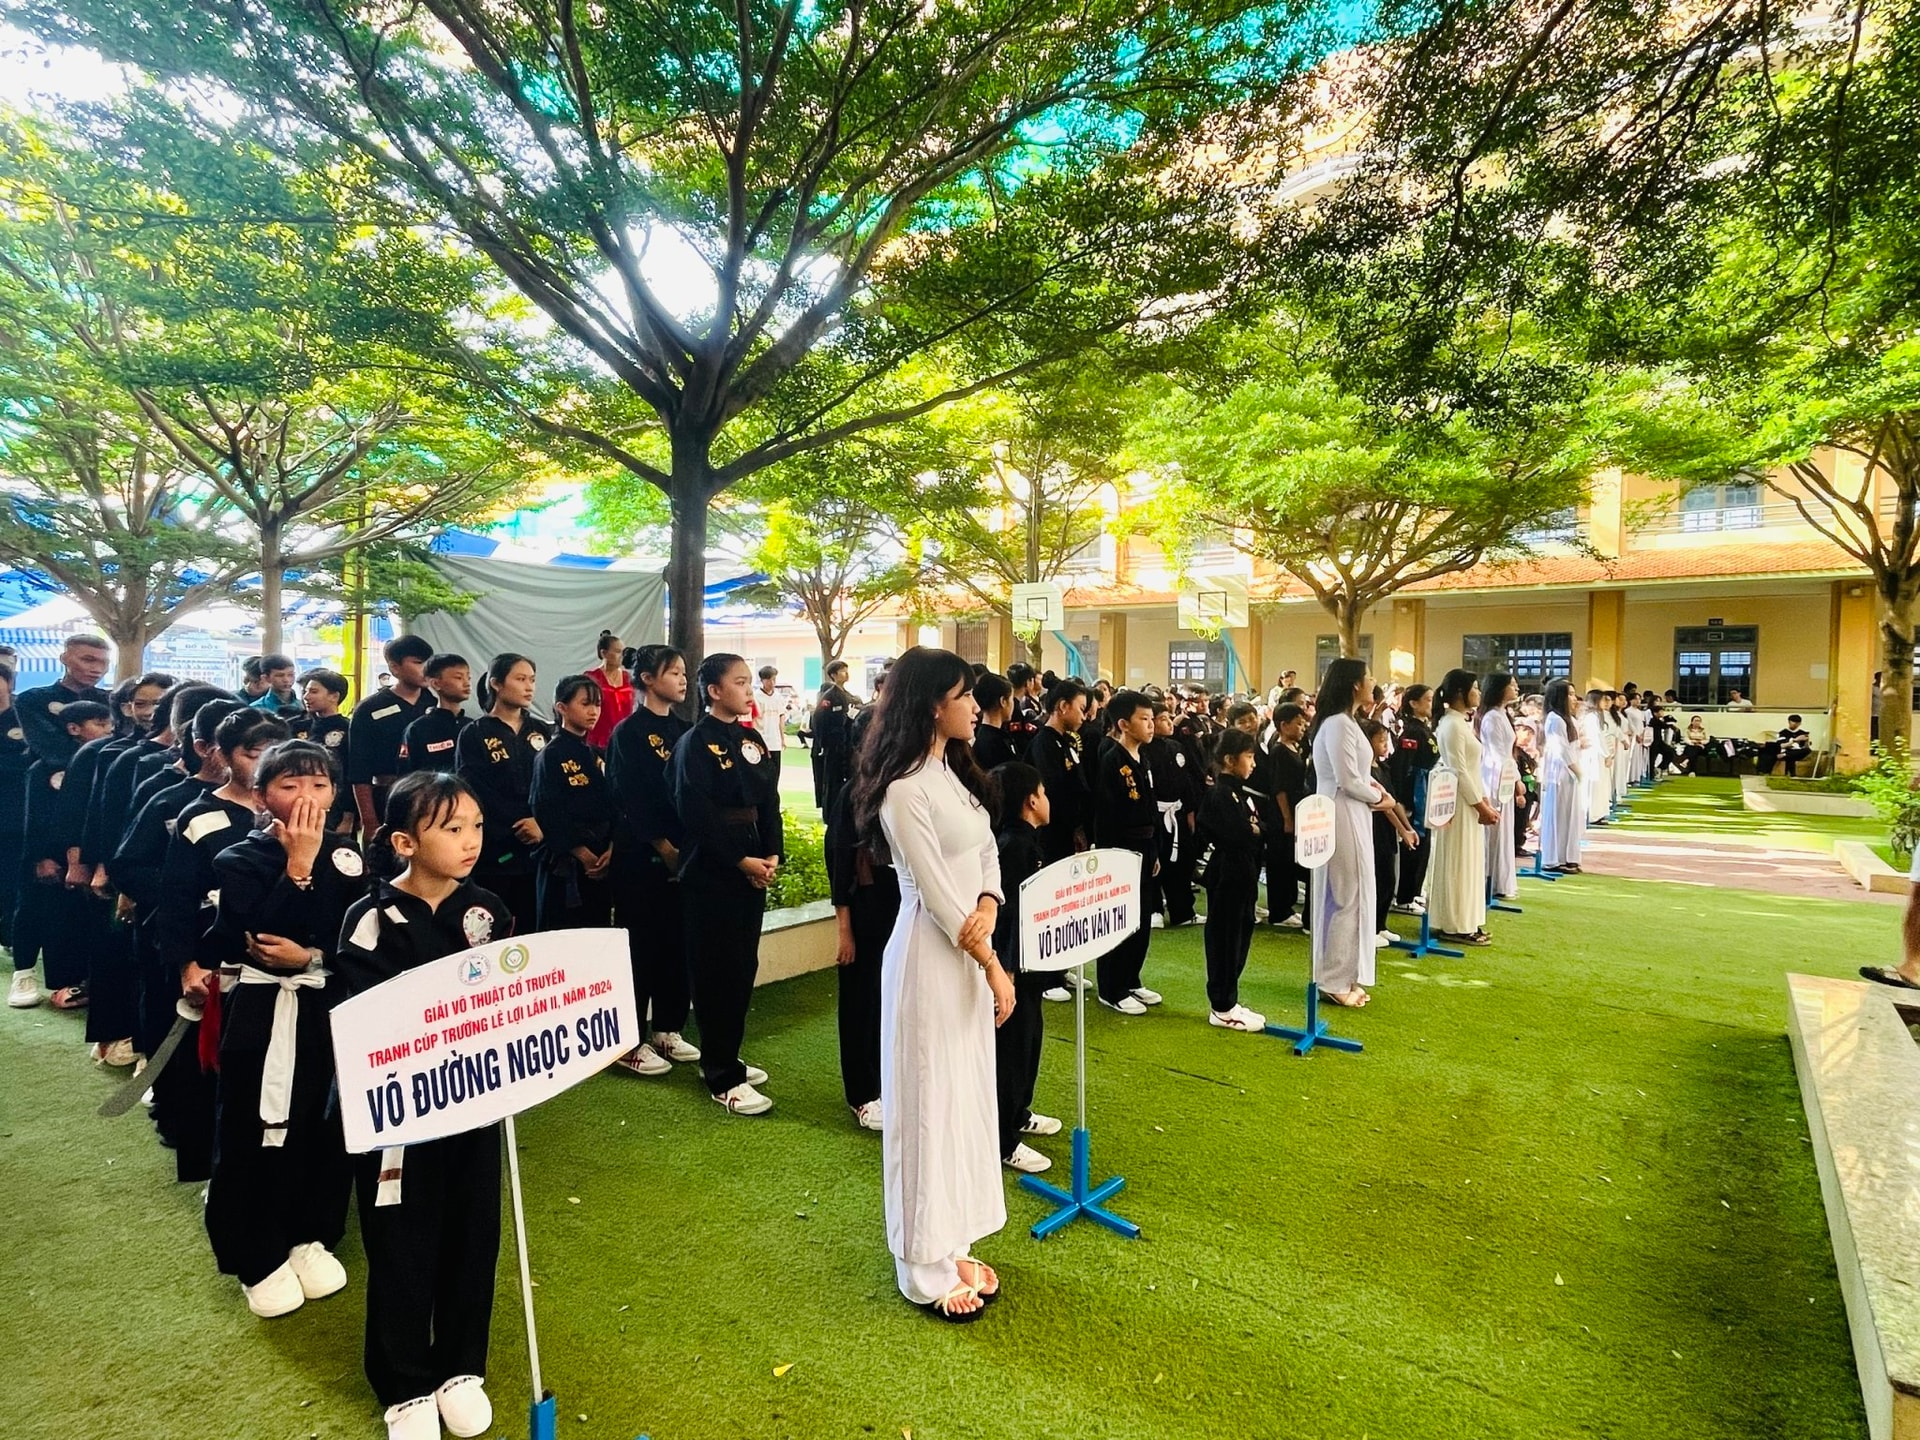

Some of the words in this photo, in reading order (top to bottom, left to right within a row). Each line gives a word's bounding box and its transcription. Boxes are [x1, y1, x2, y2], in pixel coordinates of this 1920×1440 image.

[1038, 925, 1052, 960] VÕ
[1055, 915, 1089, 954] ĐƯỜNG
[1112, 903, 1126, 932] THI
[367, 1042, 411, 1069] TRANH
[414, 1032, 438, 1054] CÚP
[441, 1019, 489, 1045] TRƯỜNG
[491, 1009, 505, 1029] LÊ
[507, 1005, 525, 1025] LỢI
[527, 996, 548, 1017] LẦN
[563, 987, 587, 1006] NĂM
[589, 979, 612, 998] 2024
[424, 999, 449, 1024] GIẢI
[452, 995, 467, 1015] VÕ
[470, 985, 505, 1010] THUẬT
[508, 976, 523, 998] CỔ
[525, 967, 565, 992] TRUYỀN
[366, 1071, 405, 1134] VÕ
[412, 1049, 502, 1118] ĐƯỜNG
[506, 1024, 570, 1084] NGỌC
[576, 1007, 620, 1057] SƠN
